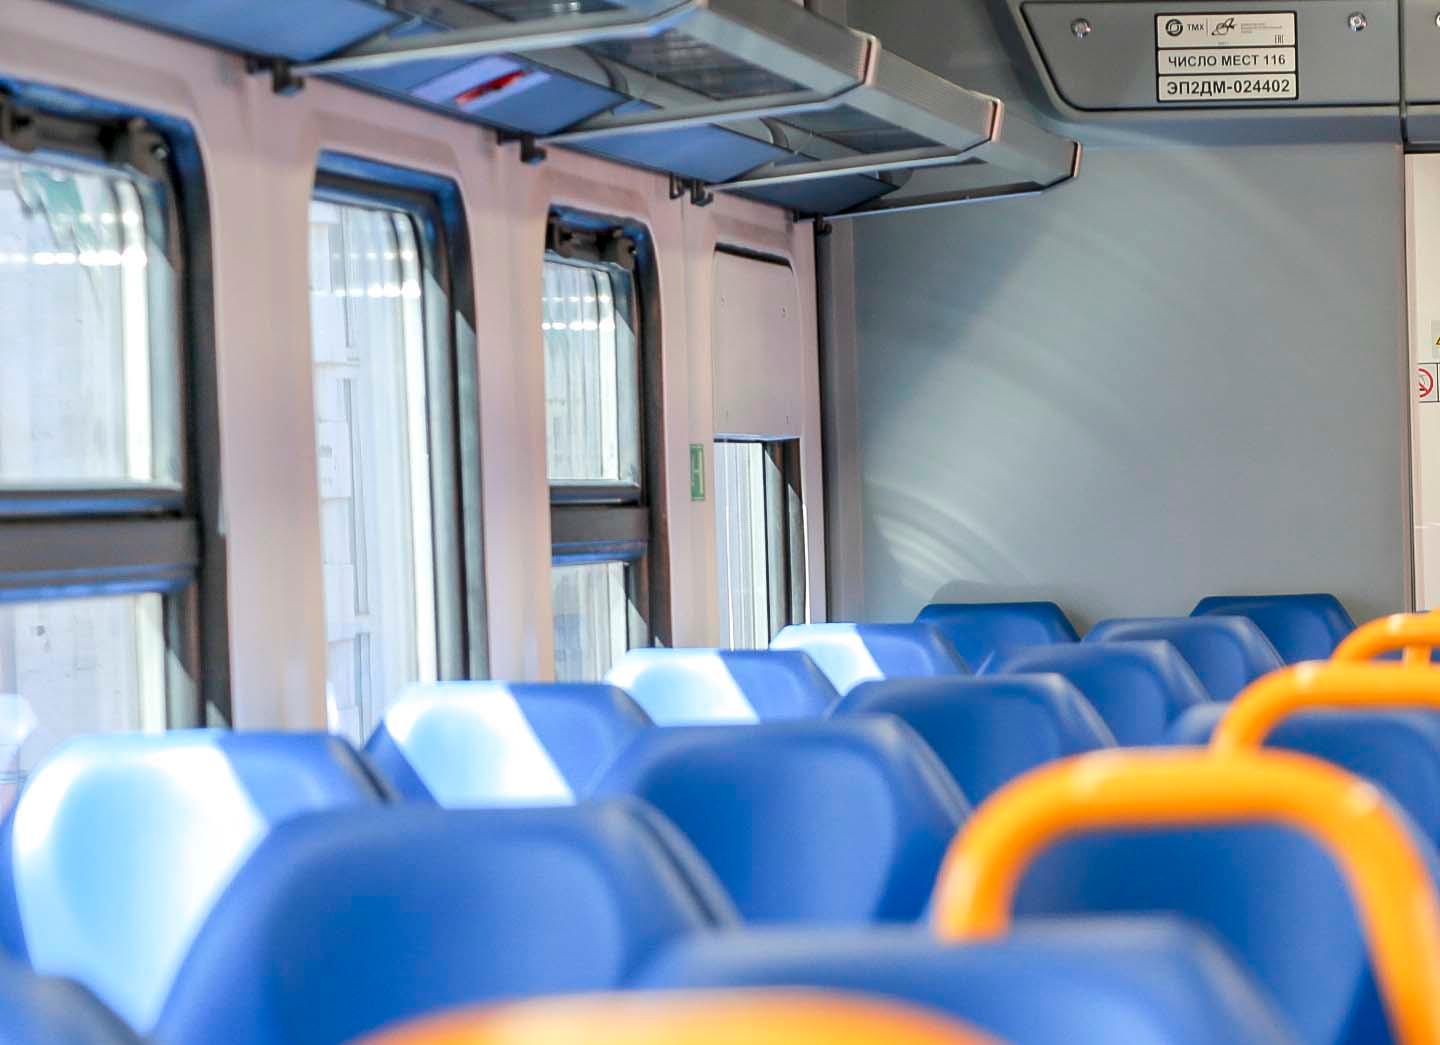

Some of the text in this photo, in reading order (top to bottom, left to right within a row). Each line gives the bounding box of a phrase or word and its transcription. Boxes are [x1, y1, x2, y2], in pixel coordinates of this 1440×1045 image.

[1168, 54, 1286, 67] ЧИСЛО МЕСТ 116
[1167, 80, 1290, 96] ЭП2ДМ-024402
